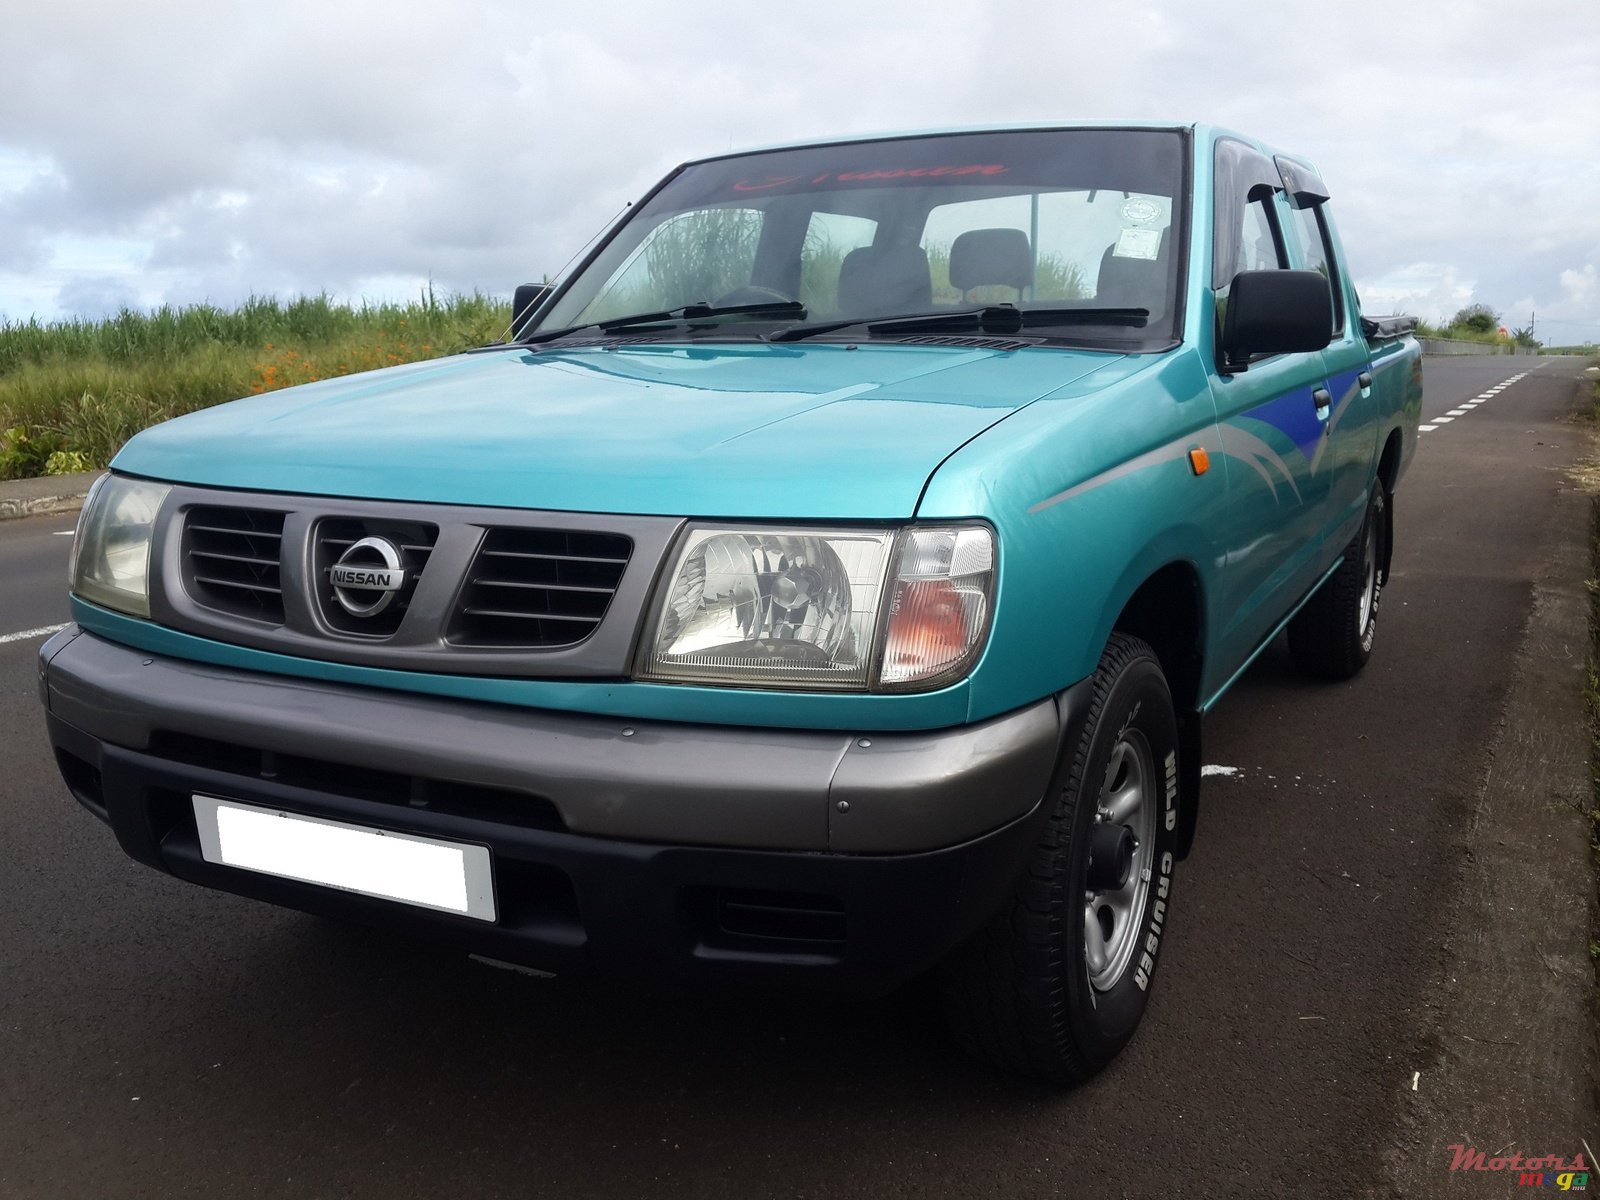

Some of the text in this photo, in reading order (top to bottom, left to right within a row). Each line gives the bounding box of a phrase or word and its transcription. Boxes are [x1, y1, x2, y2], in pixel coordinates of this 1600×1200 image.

[333, 570, 391, 586] NISSAN
[1134, 750, 1177, 992] WILD CRUISER
